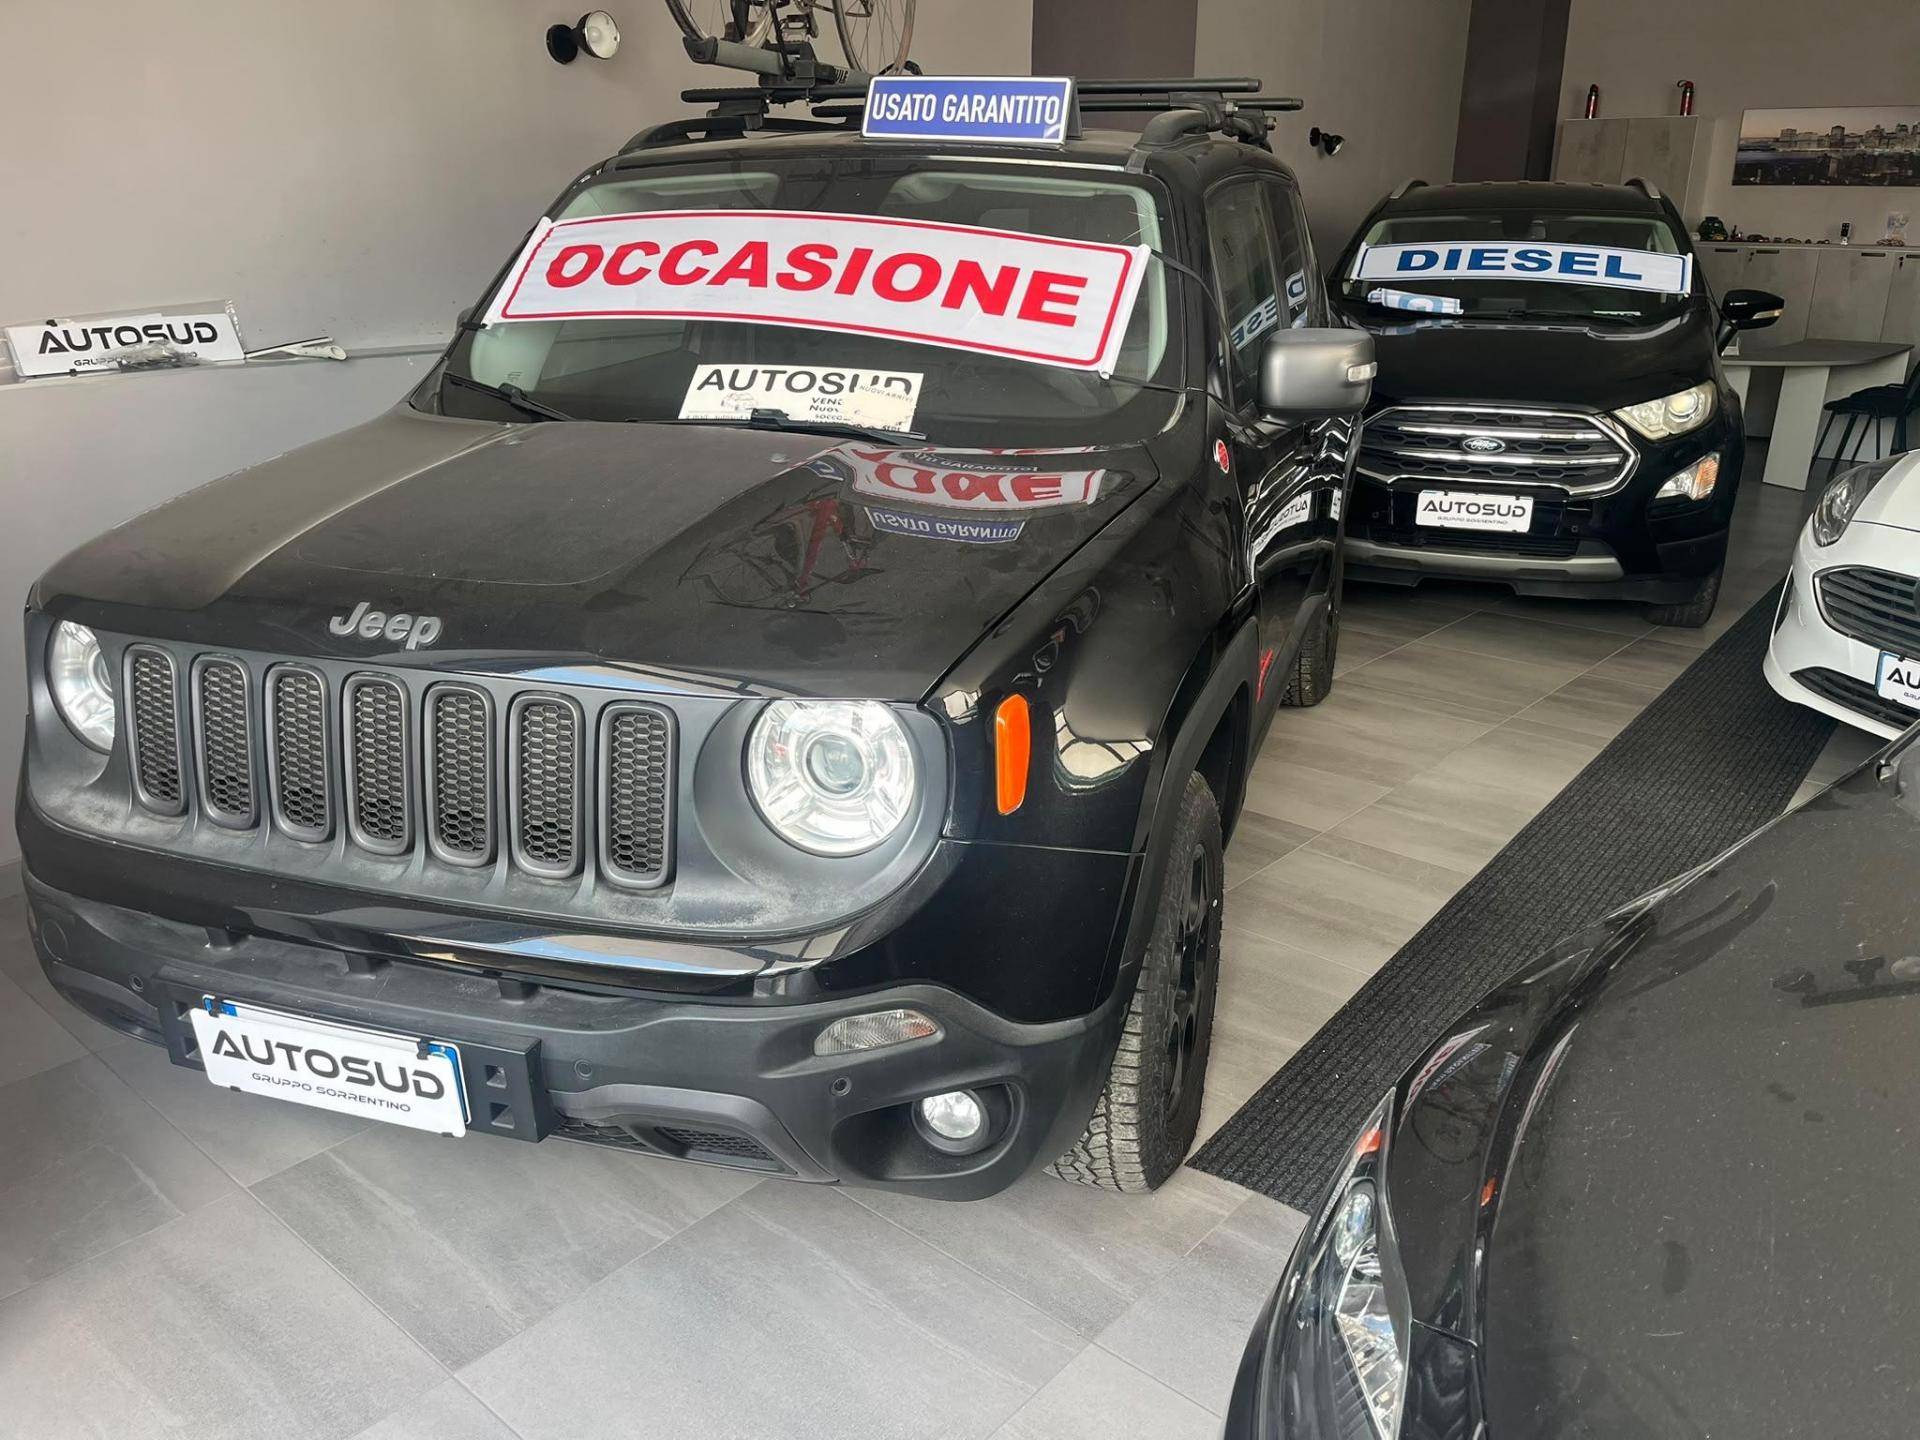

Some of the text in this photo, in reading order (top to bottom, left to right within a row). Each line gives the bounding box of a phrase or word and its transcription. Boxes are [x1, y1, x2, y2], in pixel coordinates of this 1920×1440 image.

[872, 93, 1060, 125] USATO GARANTITO
[1396, 248, 1643, 281] DIESEL
[546, 240, 1088, 327] OCCASIONE
[39, 322, 218, 354] AUTOSUD
[1423, 500, 1526, 518] AUTOSUD
[329, 602, 441, 650] Jeep
[212, 1029, 445, 1100] AUTOSUD
[252, 1071, 411, 1113] GRUPPO SORRENTINO
